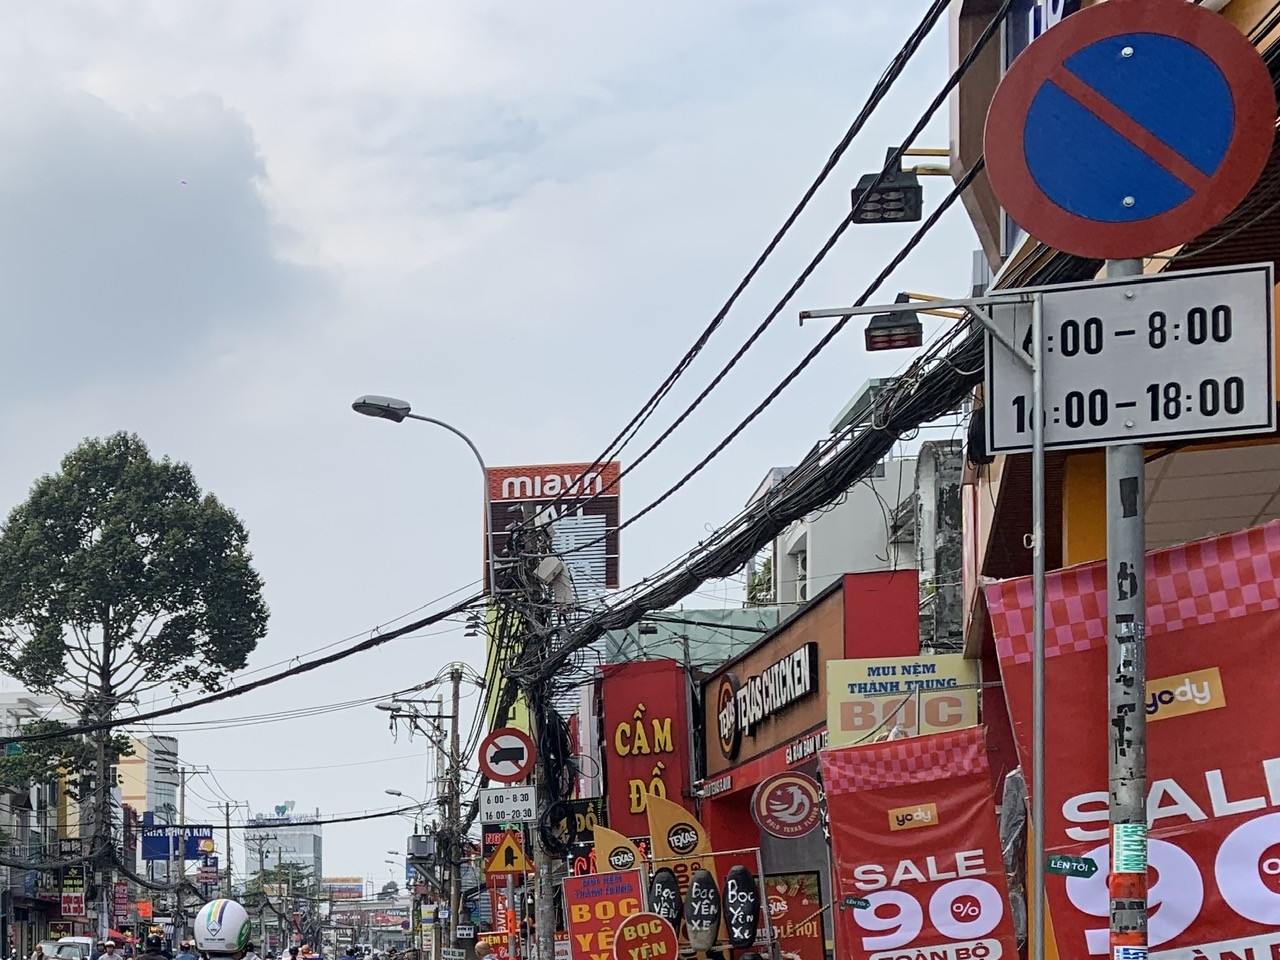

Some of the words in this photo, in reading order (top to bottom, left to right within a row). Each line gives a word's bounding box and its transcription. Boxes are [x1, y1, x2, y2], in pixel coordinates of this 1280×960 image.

[1148, 304, 1233, 349] 8:00
[1146, 376, 1245, 422] 18:00
[762, 644, 811, 717] CHICKEN
[867, 665, 896, 677] MUI
[901, 662, 936, 677] NỆM
[848, 679, 900, 694] THÀNH
[905, 678, 957, 692] TRUNG
[614, 702, 674, 757] CẦM
[895, 808, 932, 827] yody
[193, 827, 211, 837] KIM
[669, 832, 698, 848] TEXAS
[609, 853, 635, 867] TEXAS
[853, 849, 987, 891] SALE
[1051, 858, 1069, 870] LÊN
[1071, 860, 1089, 873] TỚI
[571, 898, 640, 924] BỌC
[576, 926, 615, 952] YÊ
[623, 919, 663, 941] BỌC
